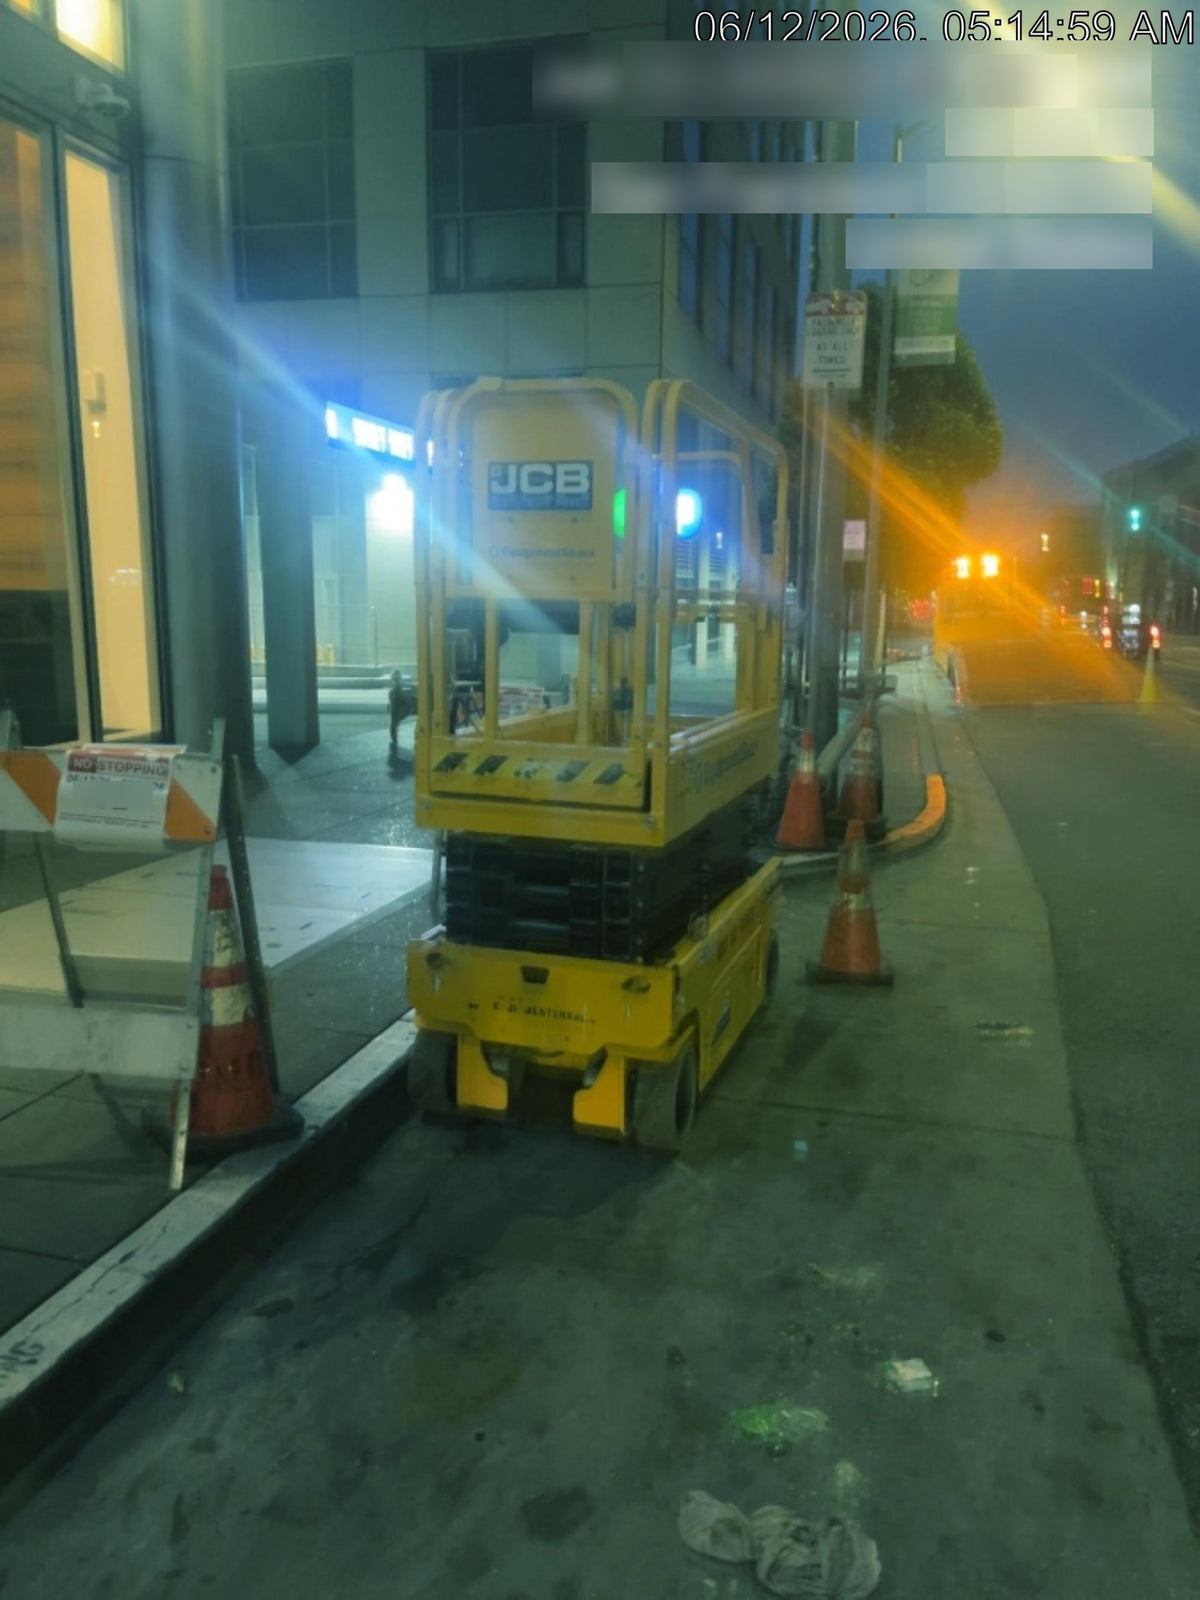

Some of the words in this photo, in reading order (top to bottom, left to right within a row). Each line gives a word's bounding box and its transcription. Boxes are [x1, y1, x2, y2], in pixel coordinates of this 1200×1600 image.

[490, 463, 591, 495] JCB
[73, 759, 92, 769] NO
[98, 760, 167, 776] STOPPING
